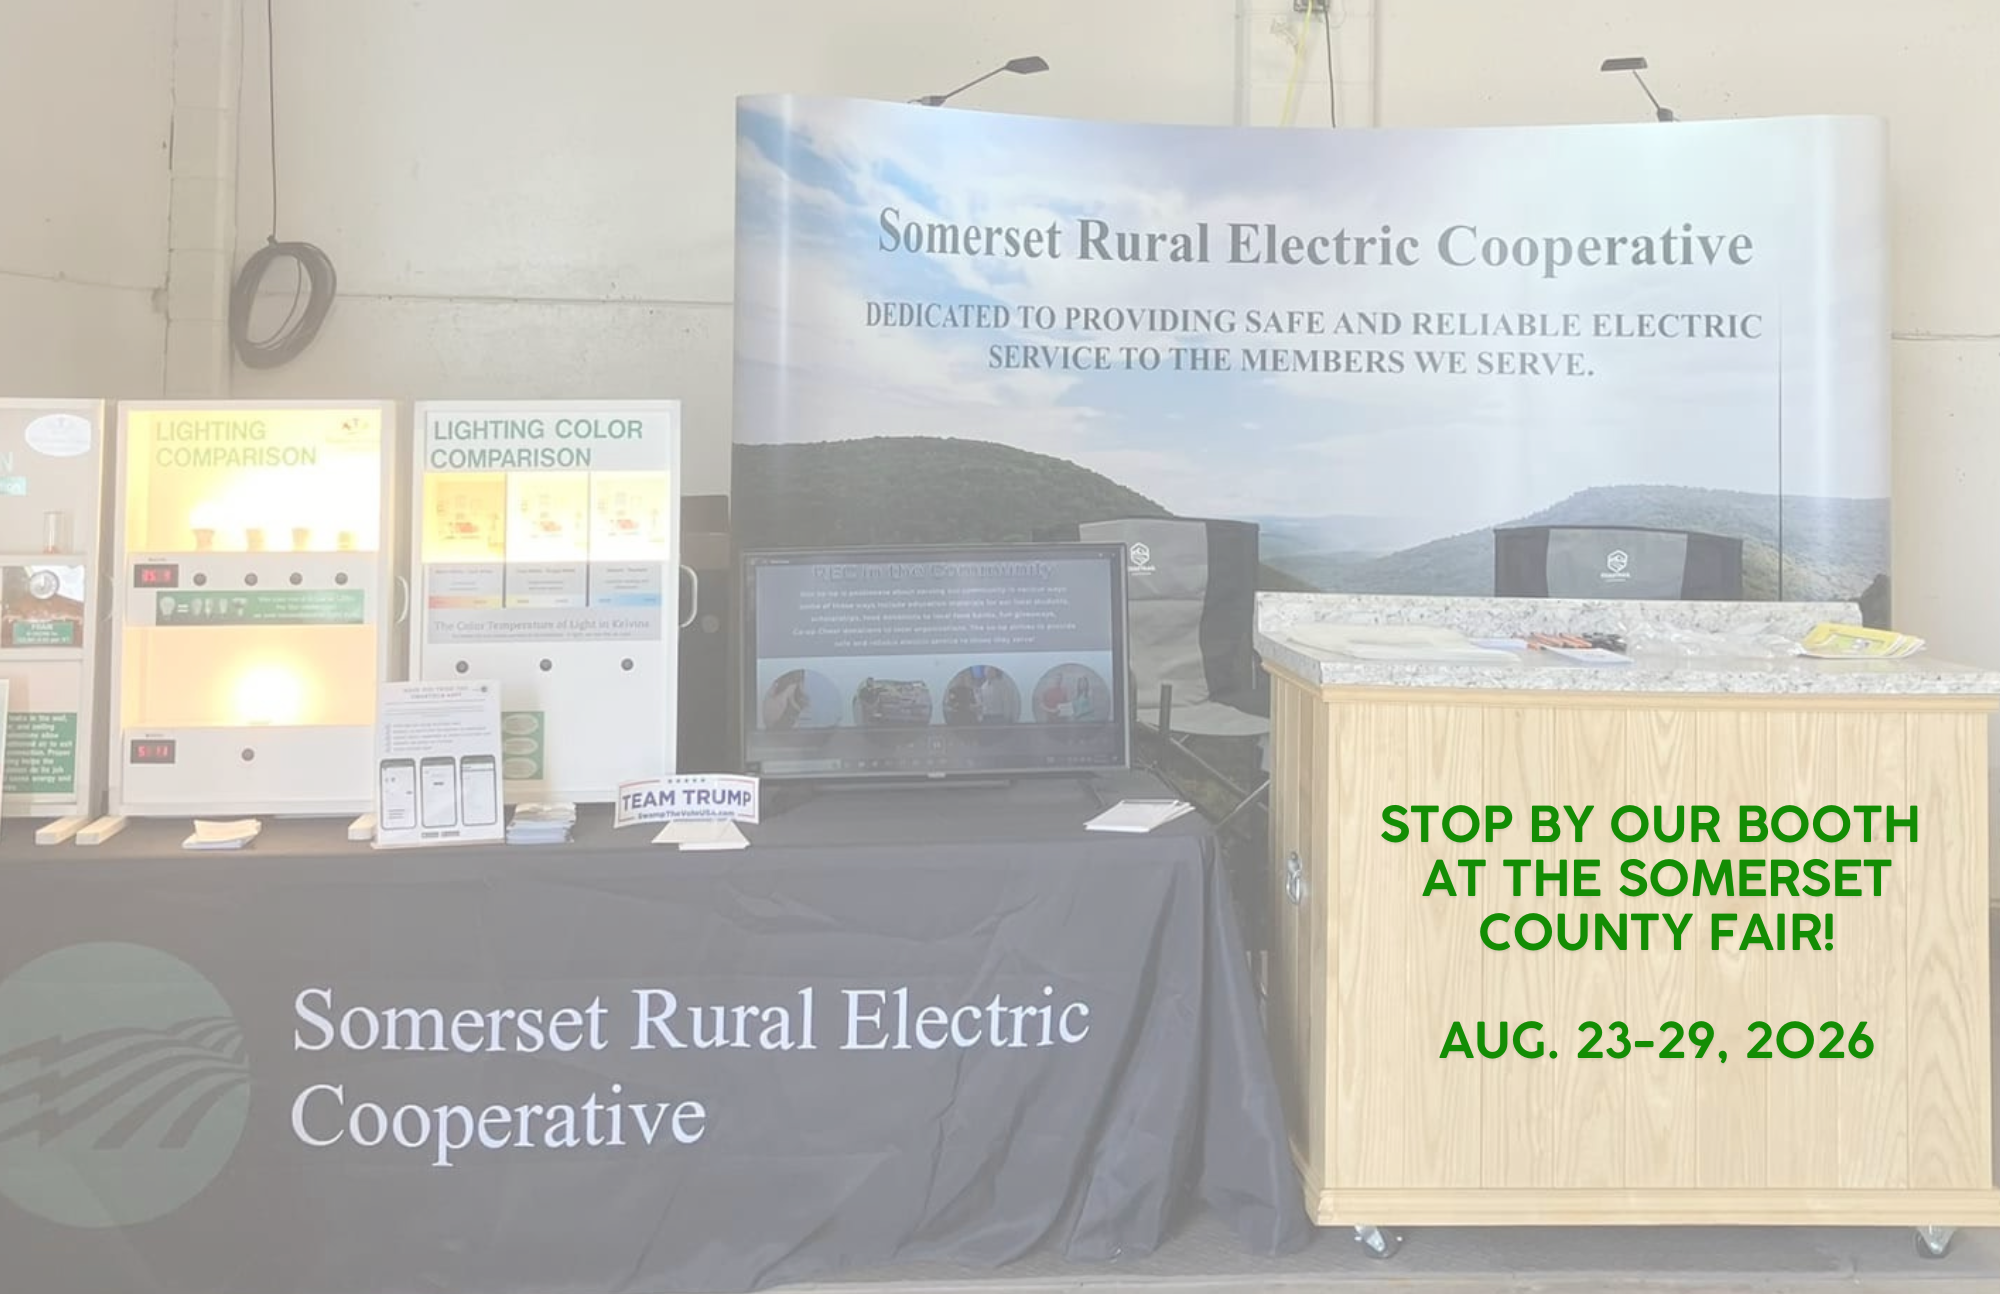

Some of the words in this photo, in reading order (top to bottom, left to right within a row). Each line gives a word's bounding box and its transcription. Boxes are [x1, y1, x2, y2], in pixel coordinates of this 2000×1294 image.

[879, 206, 1061, 259] Somerset
[1077, 219, 1209, 264] Rural
[1227, 222, 1420, 266] Electric
[1437, 223, 1754, 279] Cooperative
[866, 301, 1010, 328] DEDICATED
[1018, 305, 1056, 330] TO
[1065, 307, 1237, 334] PROVIDING
[1245, 310, 1325, 335] SAFE
[1333, 311, 1402, 336] AND
[1412, 312, 1581, 337] RELIABLE
[1592, 314, 1763, 339] ELECTRIC
[988, 345, 1111, 369] SERVICE
[1120, 346, 1161, 371] TO
[1169, 347, 1231, 371] THE
[1241, 349, 1405, 374] MEMBERS
[1414, 351, 1467, 375] WE
[1477, 351, 1595, 377] SERVE.
[155, 420, 267, 442] LIGHTING
[434, 418, 544, 441] LIGHTING
[555, 418, 643, 440] COLOR
[155, 446, 317, 467] COMPARISON
[431, 447, 592, 469] COMPARISON
[434, 620, 454, 631] The
[488, 619, 555, 632] Temperature
[556, 619, 566, 630] of
[569, 619, 596, 632] Light
[598, 619, 609, 629] in
[622, 789, 676, 812] TEAM
[682, 788, 752, 808] TRUMP
[293, 988, 608, 1052] Somerset
[630, 987, 817, 1050] Rural
[839, 985, 1091, 1050] Electric
[291, 1083, 707, 1167] Cooperative
